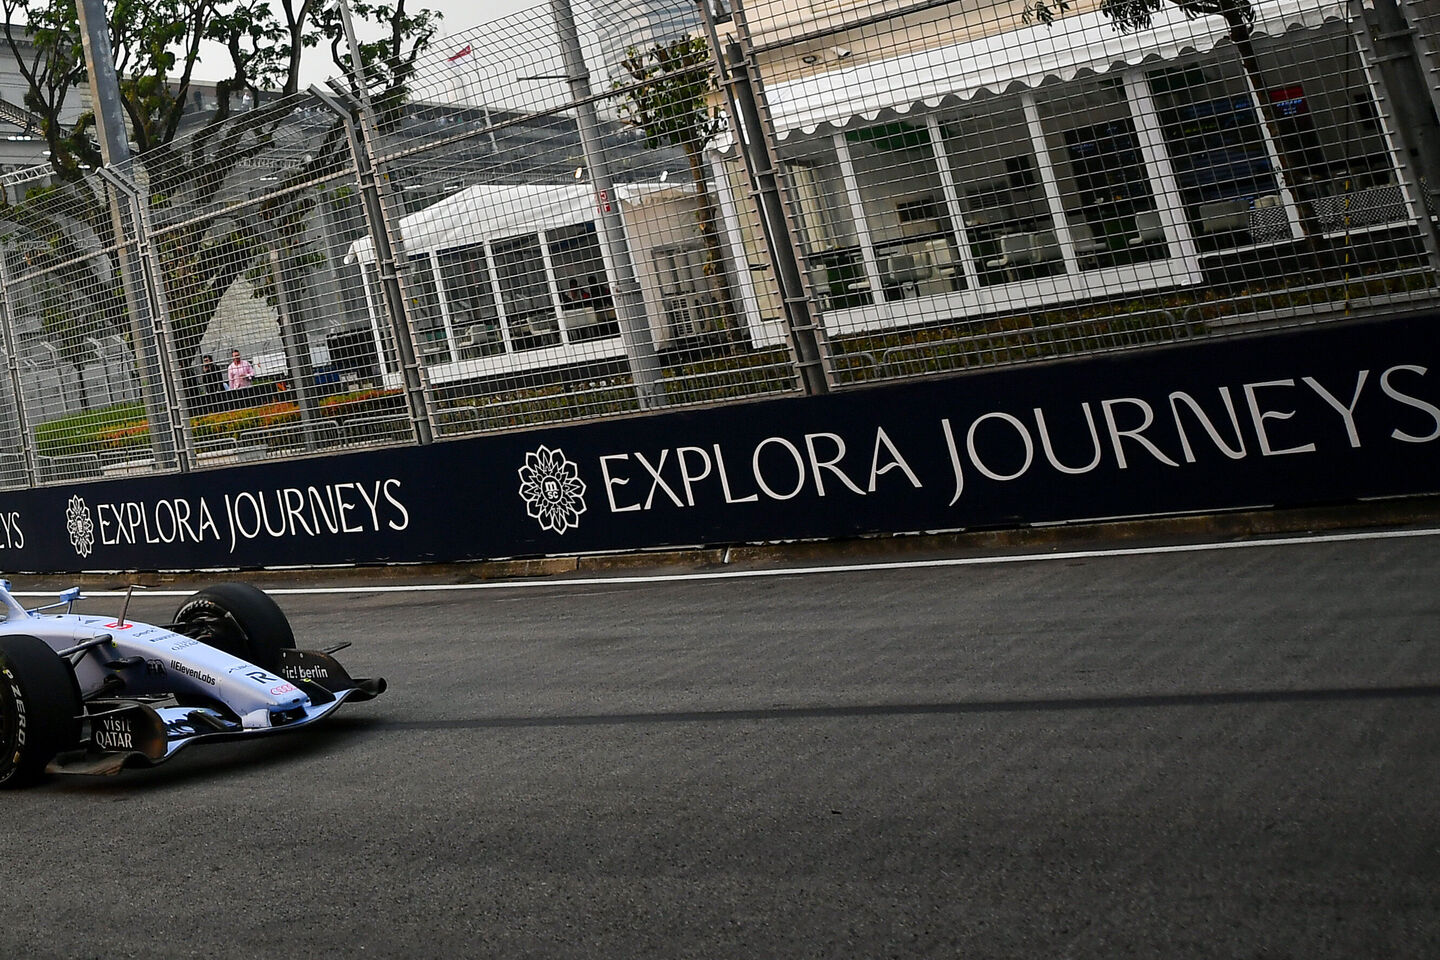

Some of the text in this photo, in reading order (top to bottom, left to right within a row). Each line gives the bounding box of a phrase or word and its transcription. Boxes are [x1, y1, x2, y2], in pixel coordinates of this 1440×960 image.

[599, 364, 1440, 513] EXPLORA JOURNEYS
[96, 478, 409, 554] EXPLORA JOURNEYS
[299, 665, 329, 679] berlin
[11, 685, 27, 746] ZERO
[104, 716, 132, 731] visit
[96, 730, 133, 749] QATAR
